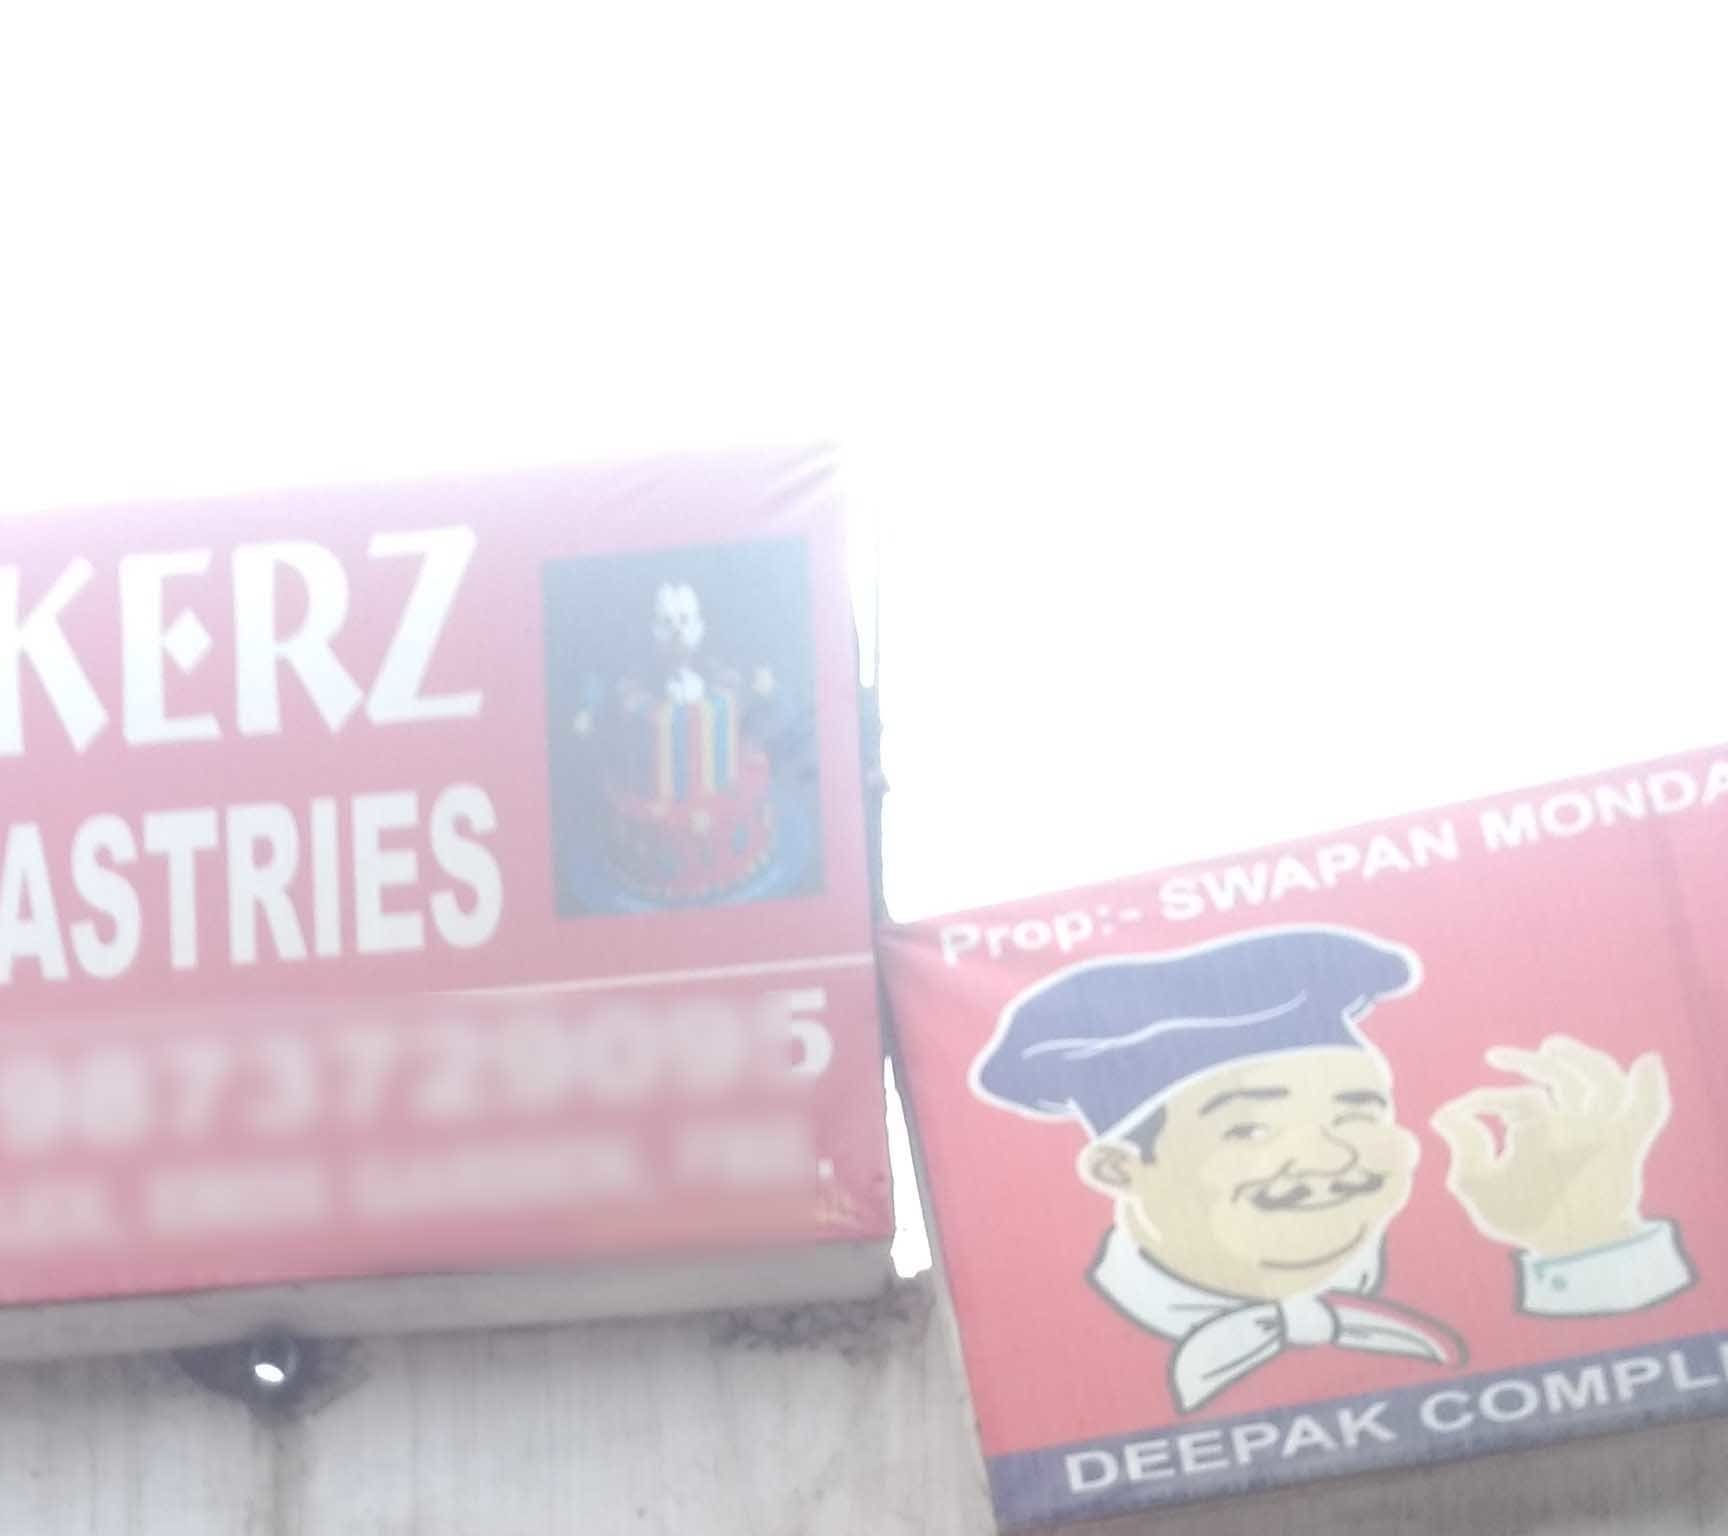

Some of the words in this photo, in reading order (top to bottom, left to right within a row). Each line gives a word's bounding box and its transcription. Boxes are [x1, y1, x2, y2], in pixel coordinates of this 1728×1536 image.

[1158, 822, 1461, 922] SWAPAN
[1065, 1403, 1396, 1494] DEEPAK
[1420, 1340, 1728, 1432] COMPL
